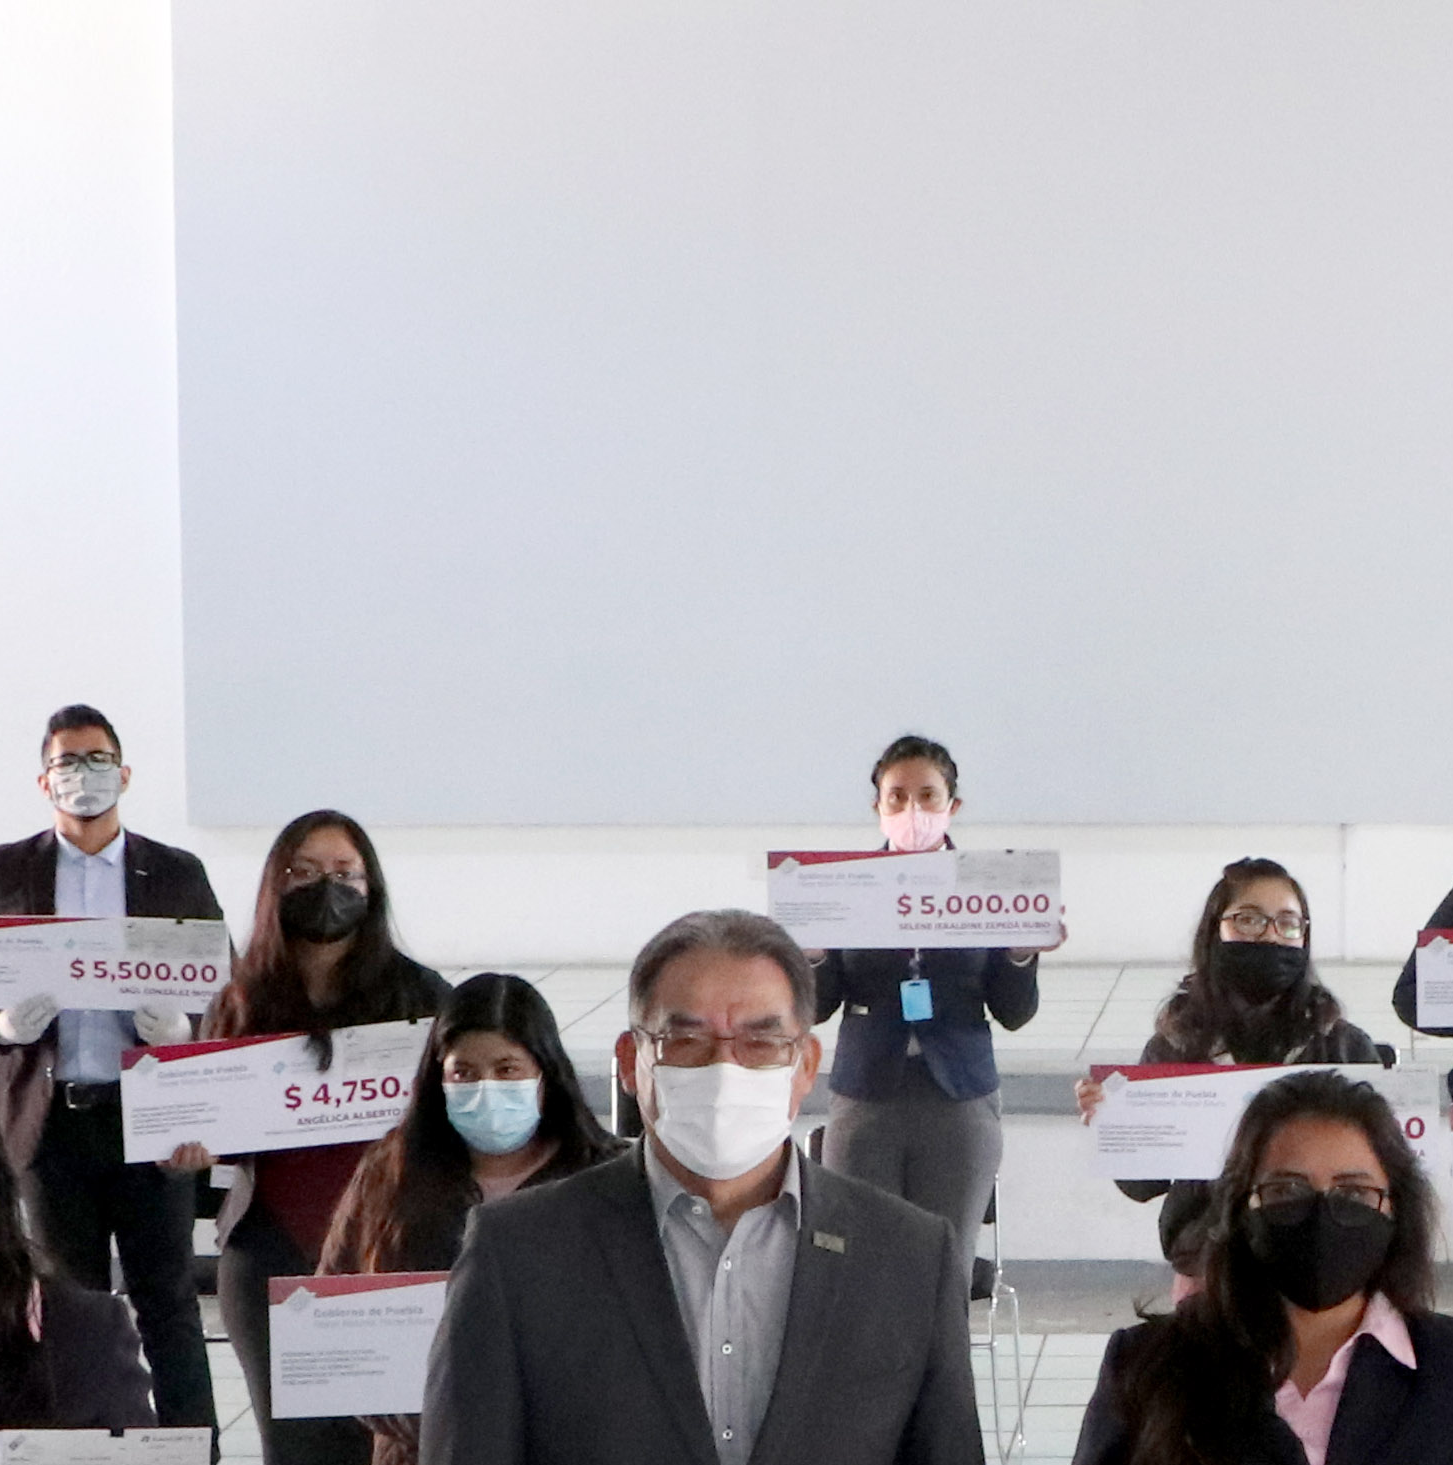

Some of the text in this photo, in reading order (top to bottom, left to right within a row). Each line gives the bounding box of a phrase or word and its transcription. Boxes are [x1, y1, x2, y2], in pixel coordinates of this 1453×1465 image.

[897, 893, 1050, 918] $ 5,000.00
[70, 958, 218, 983] $ 5,500.00
[284, 1084, 302, 1111] $
